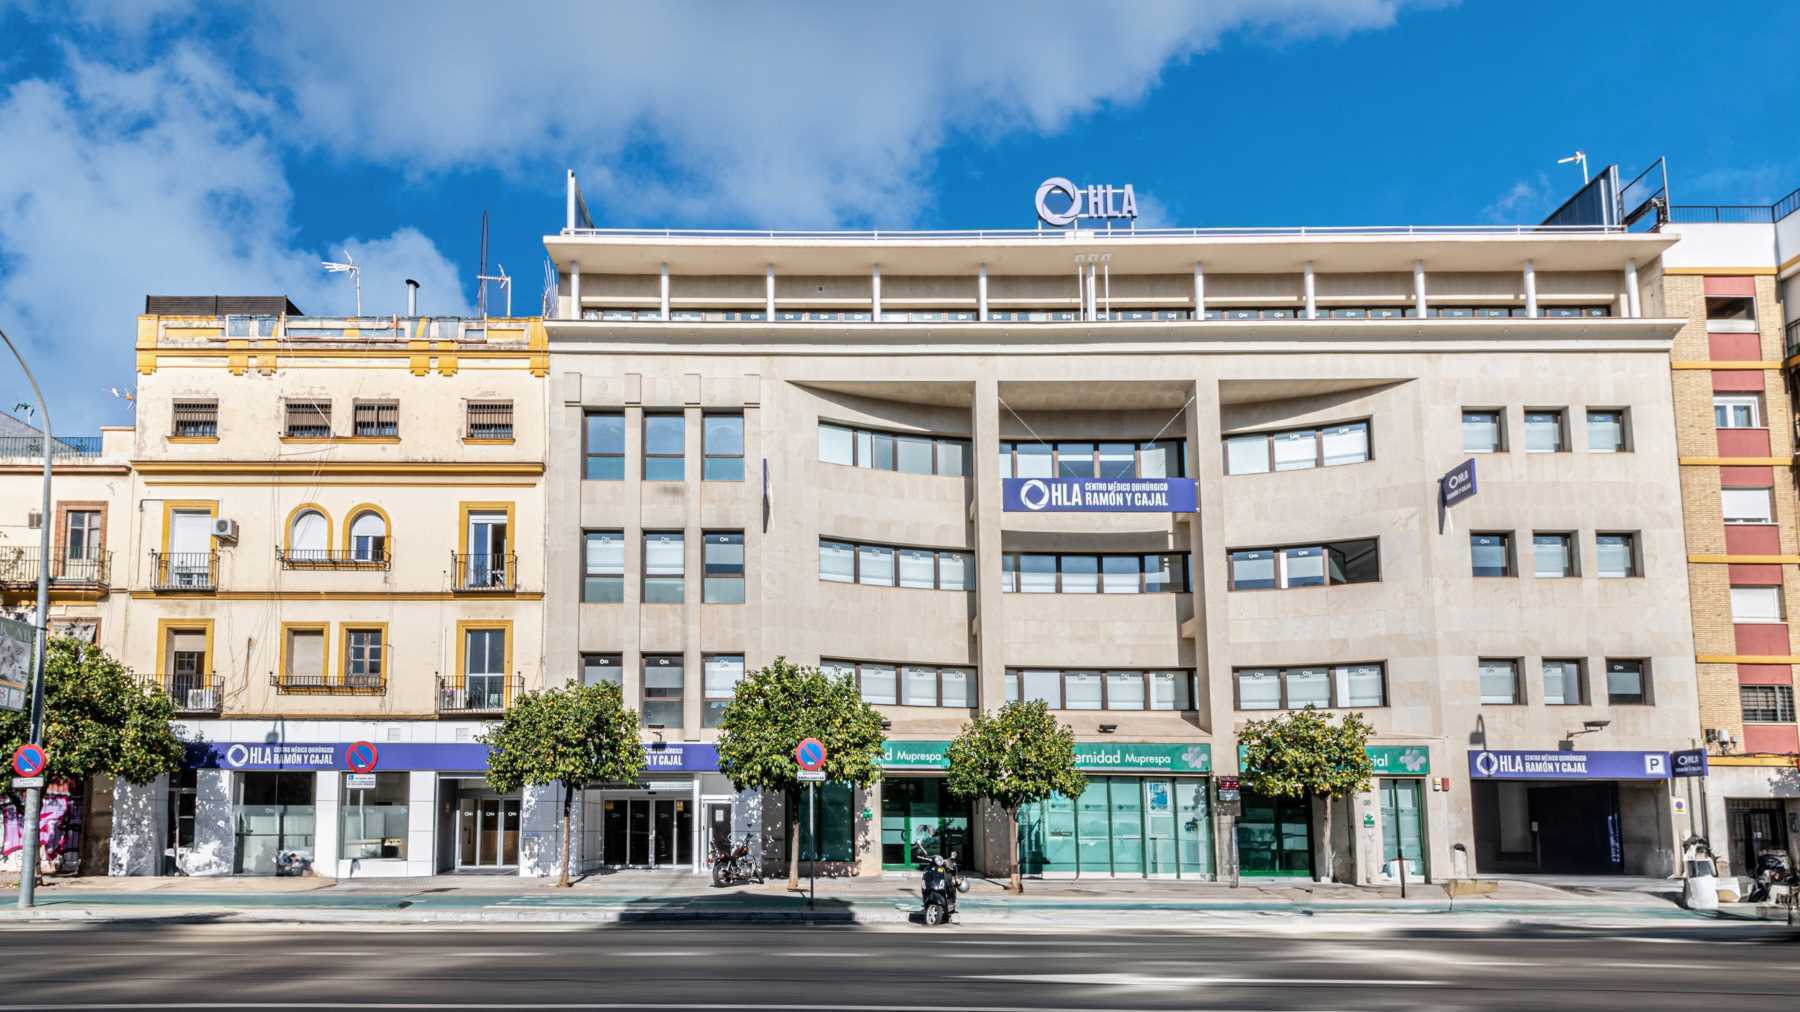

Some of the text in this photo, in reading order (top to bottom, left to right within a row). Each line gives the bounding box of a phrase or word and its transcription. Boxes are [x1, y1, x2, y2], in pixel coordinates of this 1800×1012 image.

[1087, 184, 1138, 218] HLA
[1084, 481, 1169, 492] CENTRO MÉDICO QUIRÚRGICO
[1051, 483, 1083, 506] HLA
[1085, 490, 1168, 506] RAMÓN Y CAJAL
[249, 746, 272, 764] HLA
[273, 752, 333, 765] RAMÓN Y CAJAL
[659, 755, 683, 766] CAJAL
[896, 751, 942, 763] Muprespa
[1075, 750, 1171, 765] ernidad Muprespa
[1500, 755, 1524, 772] HLA
[1525, 761, 1588, 773] RAMÓN Y CAJAL
[1649, 758, 1660, 771] P
